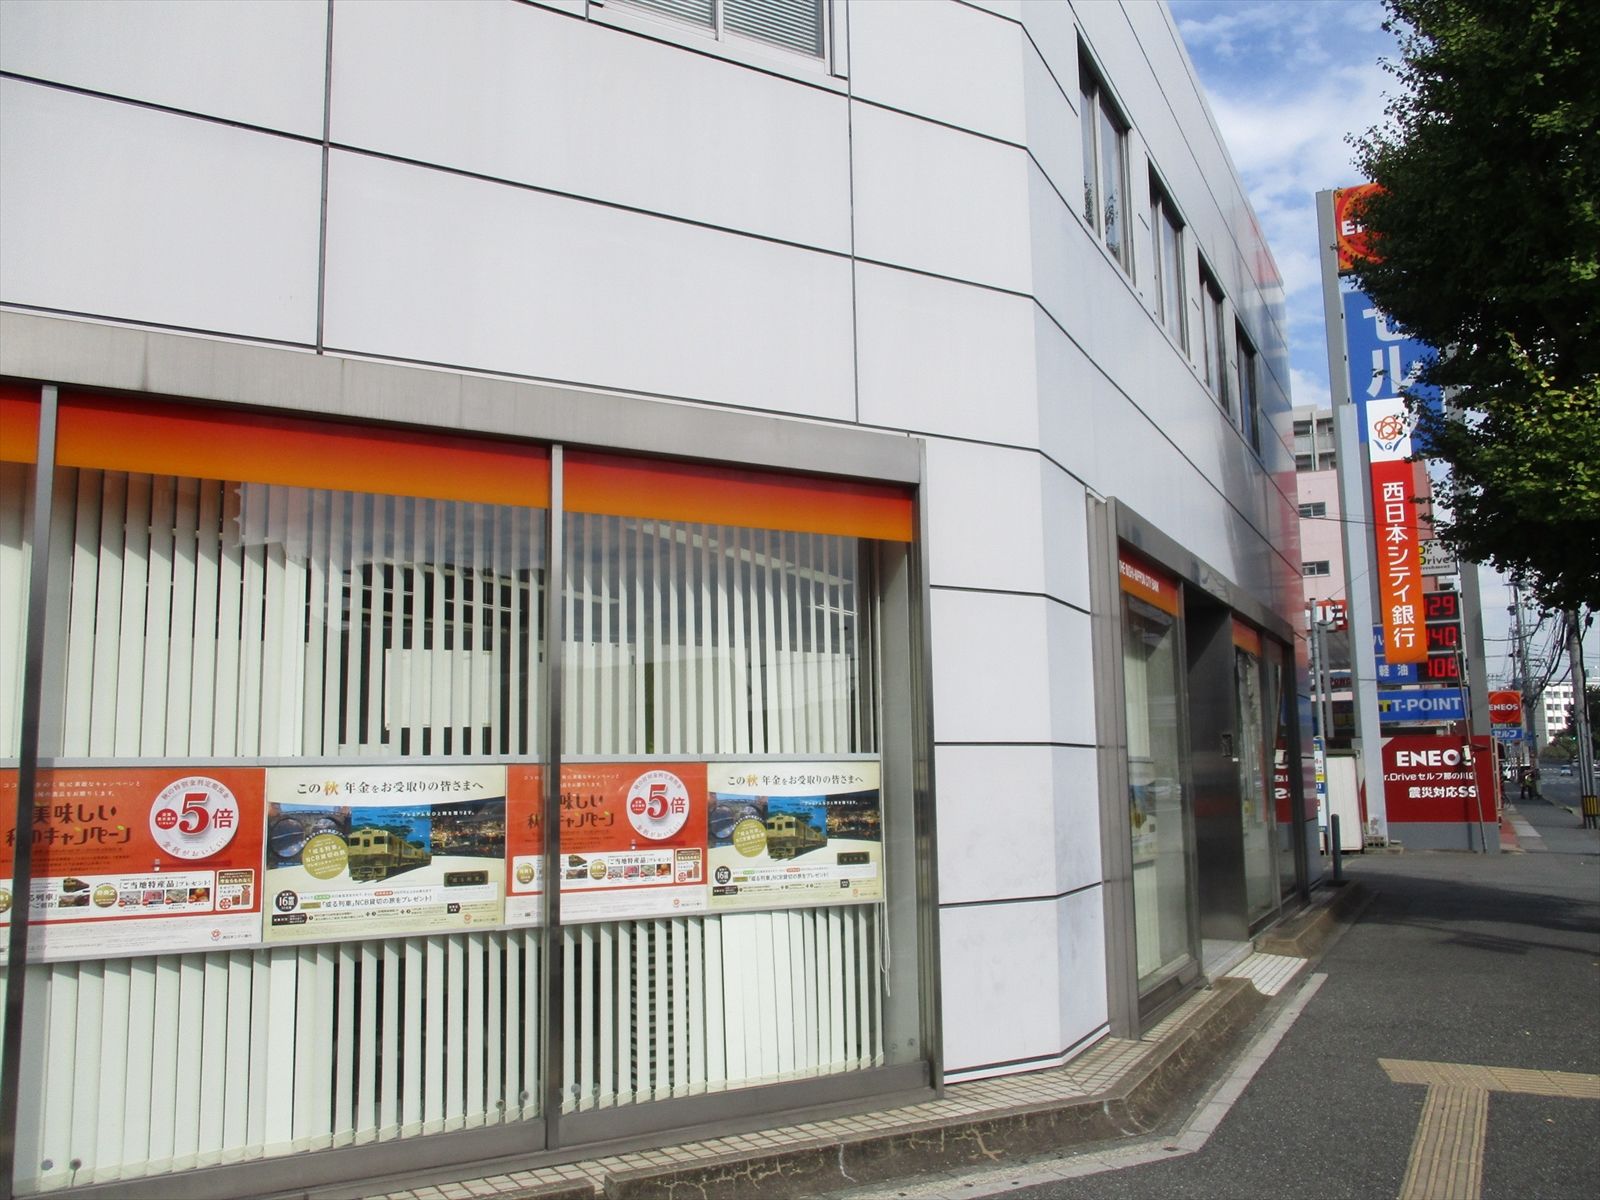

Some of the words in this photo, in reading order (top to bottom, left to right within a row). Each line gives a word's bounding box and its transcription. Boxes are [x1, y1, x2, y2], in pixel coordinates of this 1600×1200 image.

[1382, 482, 1415, 648] 西日本シティ銀行
[1391, 697, 1461, 712] T-POINT
[1493, 730, 1517, 738] セルフ
